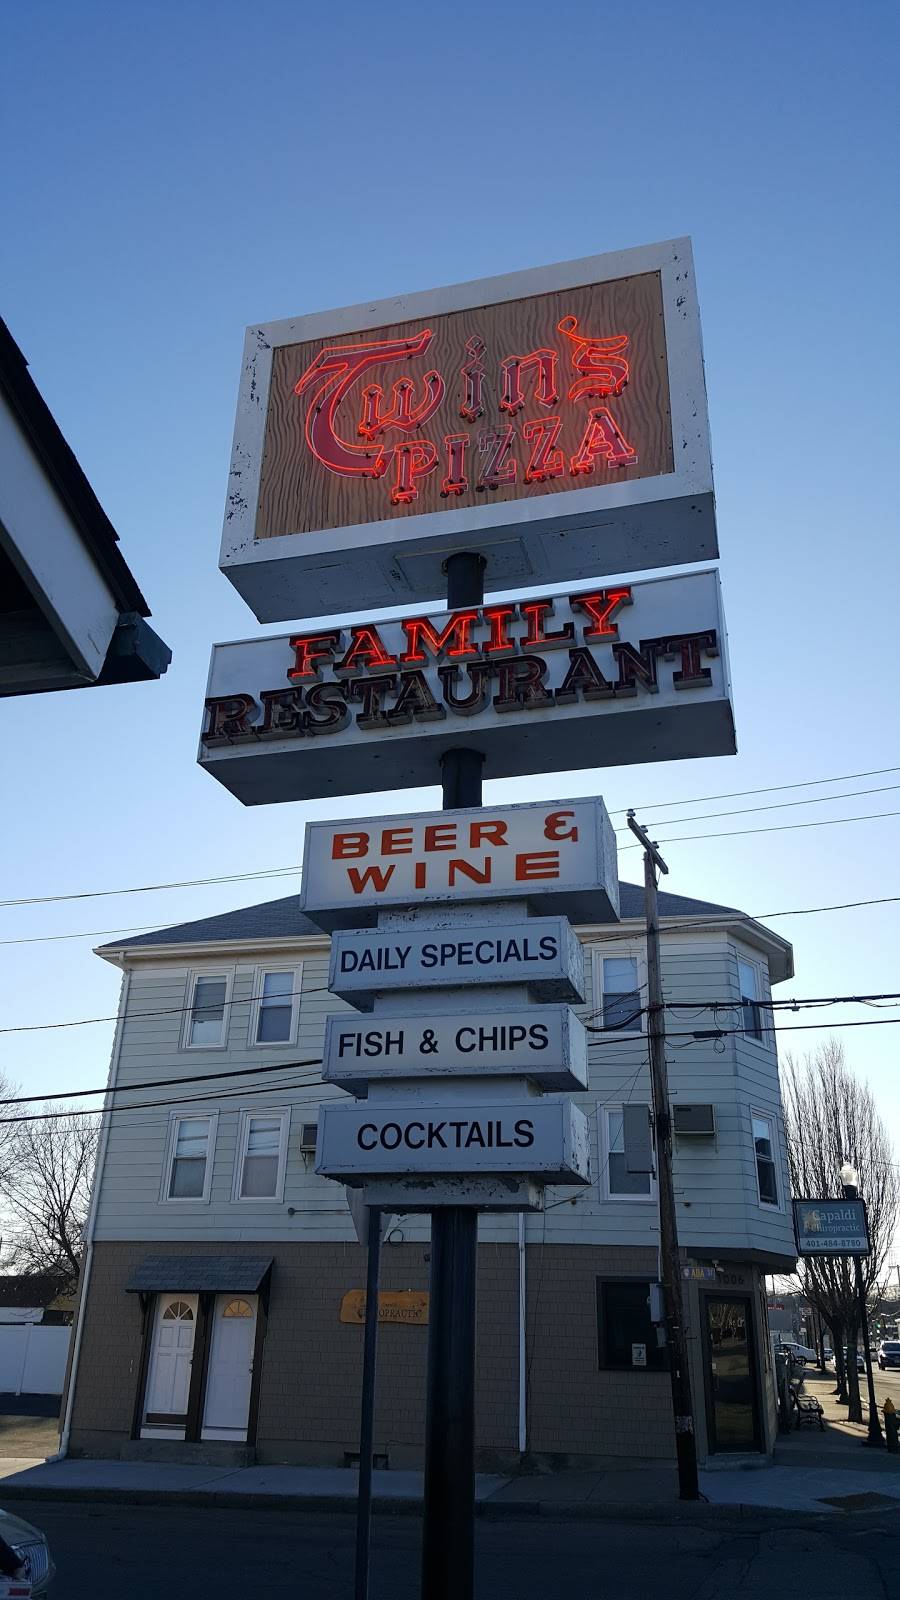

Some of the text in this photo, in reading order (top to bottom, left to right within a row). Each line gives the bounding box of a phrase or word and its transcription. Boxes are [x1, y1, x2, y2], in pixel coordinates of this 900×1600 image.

[392, 407, 637, 503] PIZZA
[288, 587, 632, 683] FAMILY
[202, 630, 717, 745] RESTAURANT
[331, 811, 578, 860] BEER &
[347, 850, 560, 894] WINE
[340, 936, 558, 973] DAILY SPECIALS
[338, 1023, 549, 1058] FISH & CHIPS
[356, 1119, 535, 1151] COCKTAILS
[812, 1209, 857, 1223] Capaldi
